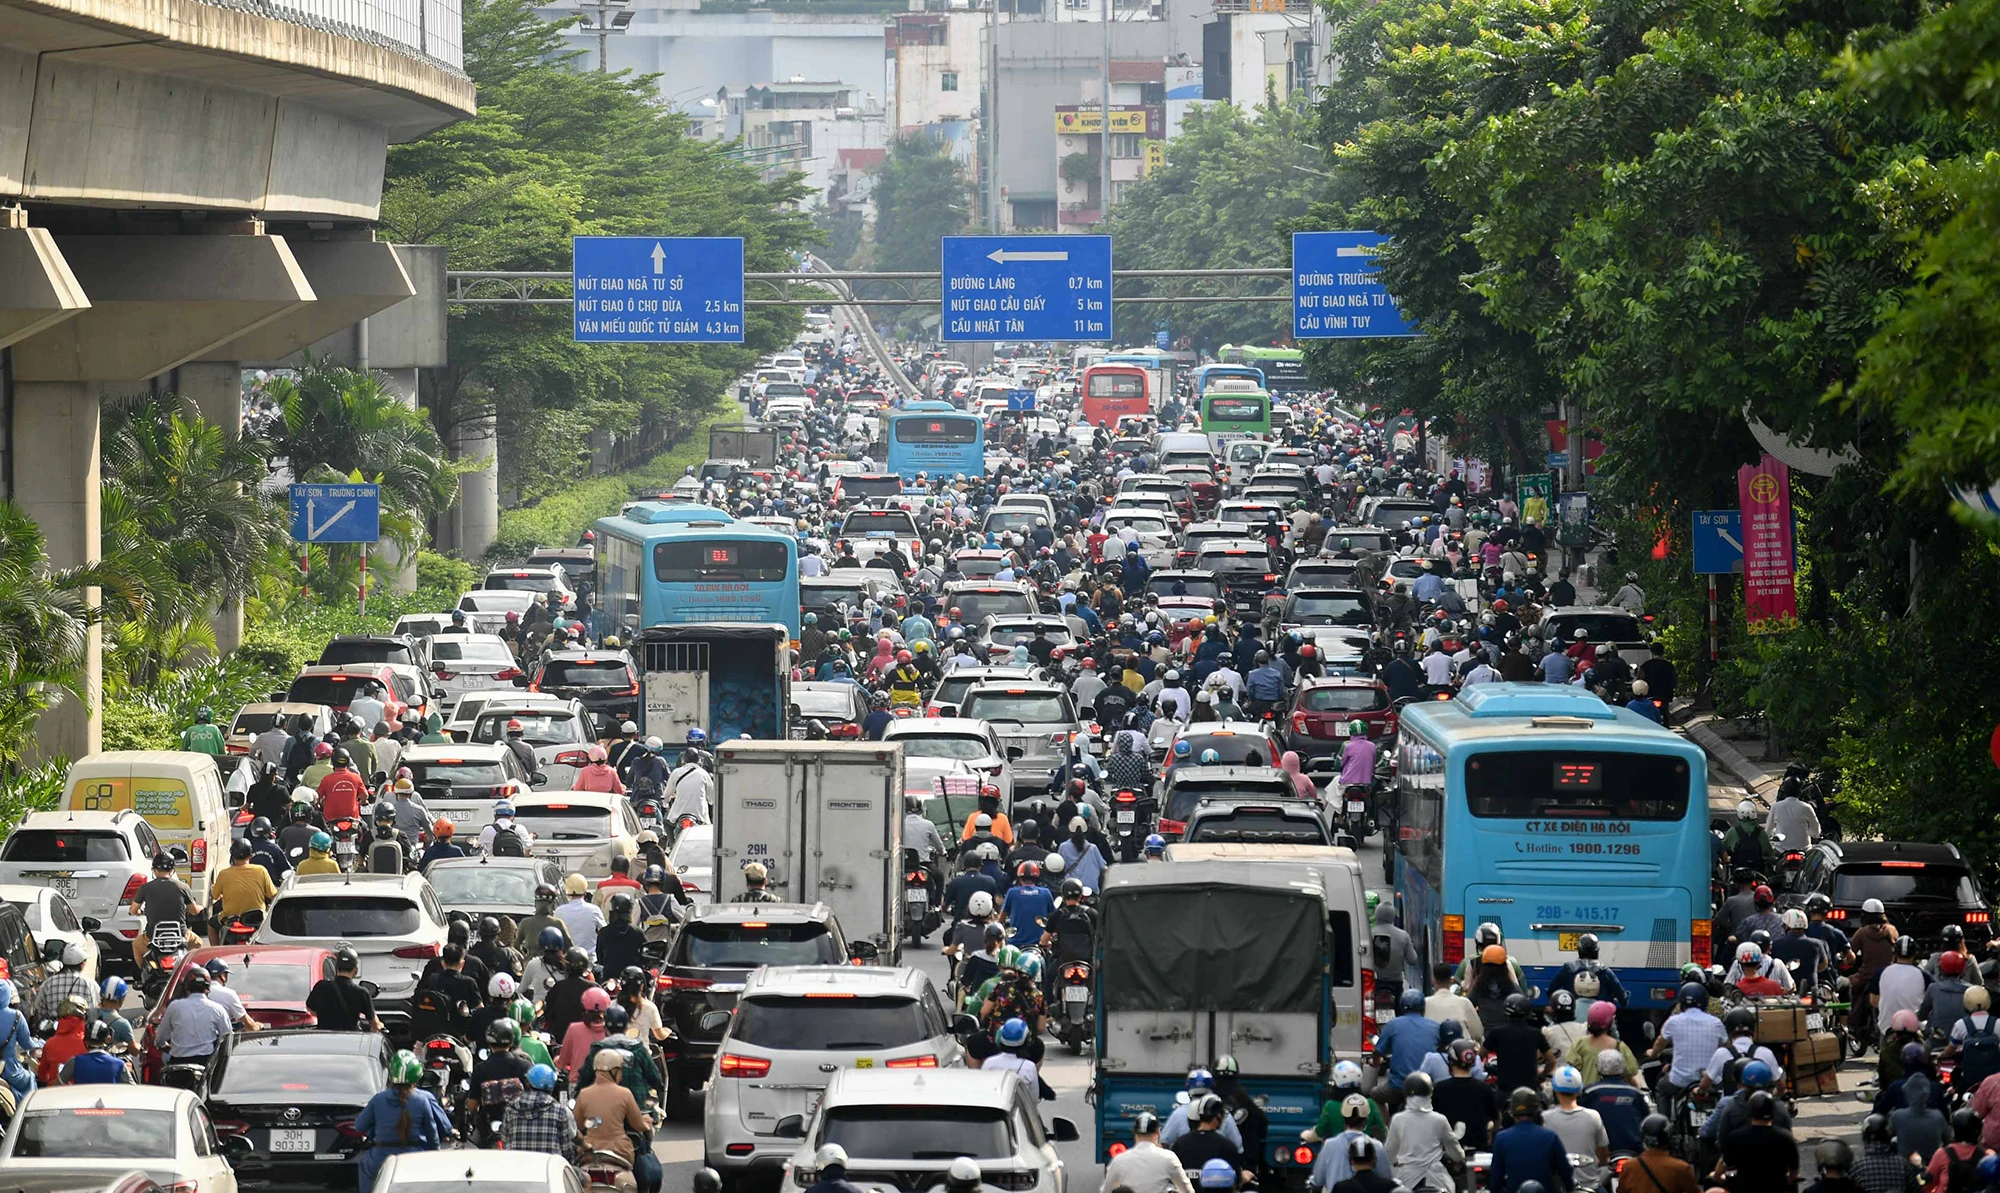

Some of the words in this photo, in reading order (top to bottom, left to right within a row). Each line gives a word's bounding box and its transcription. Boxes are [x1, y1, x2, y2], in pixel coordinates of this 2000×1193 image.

[578, 275, 598, 290] NÚT
[601, 278, 624, 290] GIAO
[628, 276, 647, 290] NGÃ
[653, 278, 665, 290] TƯ
[670, 275, 684, 290] SỞ
[951, 274, 985, 289] ĐƯỜNG
[989, 274, 1015, 289] LÁNG
[1087, 277, 1102, 289] km
[1299, 270, 1334, 286] ĐƯỜNG
[578, 296, 598, 312] NÚT
[601, 300, 624, 312] GIAO
[628, 297, 634, 312] Ô
[638, 299, 658, 315] CHỢ
[662, 296, 682, 312] DỪA
[724, 300, 739, 312] km
[951, 296, 971, 311] NÚT
[974, 298, 996, 311] GIAO
[1000, 295, 1020, 311] CẦU
[1024, 294, 1046, 311] GIẤY
[1078, 299, 1083, 310] 5
[1087, 298, 1103, 310] km
[1300, 292, 1319, 308] NÚT
[1323, 294, 1345, 307] GIAO
[1348, 292, 1369, 307] NGÃ
[1372, 294, 1385, 306] TƯ
[579, 319, 598, 333] VĂN
[601, 317, 625, 333] MIẾU
[628, 317, 654, 334] QUỐC
[658, 318, 671, 333] TỬ
[674, 318, 698, 333] GIÁM
[724, 321, 739, 333] km
[951, 317, 970, 332] CẦU
[975, 318, 1000, 334] NHẬT
[1005, 318, 1024, 332] TÂN
[1074, 320, 1084, 332] 11
[1088, 320, 1103, 332] km
[1300, 313, 1319, 329] CẦU
[1324, 315, 1347, 328] VĨNH
[1352, 316, 1371, 328] TUY
[294, 487, 306, 497] TÂY
[308, 487, 322, 497] SƠN
[329, 486, 355, 497] TRƯỜNG
[357, 489, 376, 497] CHINH
[1699, 513, 1711, 524] TÂY
[1713, 514, 1728, 525] SƠN
[713, 550, 728, 561] 01
[191, 731, 213, 740] Grab
[1526, 822, 1541, 832] CT
[1544, 822, 1557, 832] XE
[1561, 820, 1587, 836] ĐIỆN
[1609, 820, 1630, 836] NỘI
[748, 844, 767, 855] 29H
[1526, 843, 1563, 853] Hotline
[1569, 843, 1641, 854] 1900.1296
[56, 880, 71, 888] 30E
[1537, 906, 1561, 919] 29B
[1575, 908, 1619, 920] 415.17
[284, 1130, 303, 1140] 30H
[275, 1141, 310, 1151] 903.33
